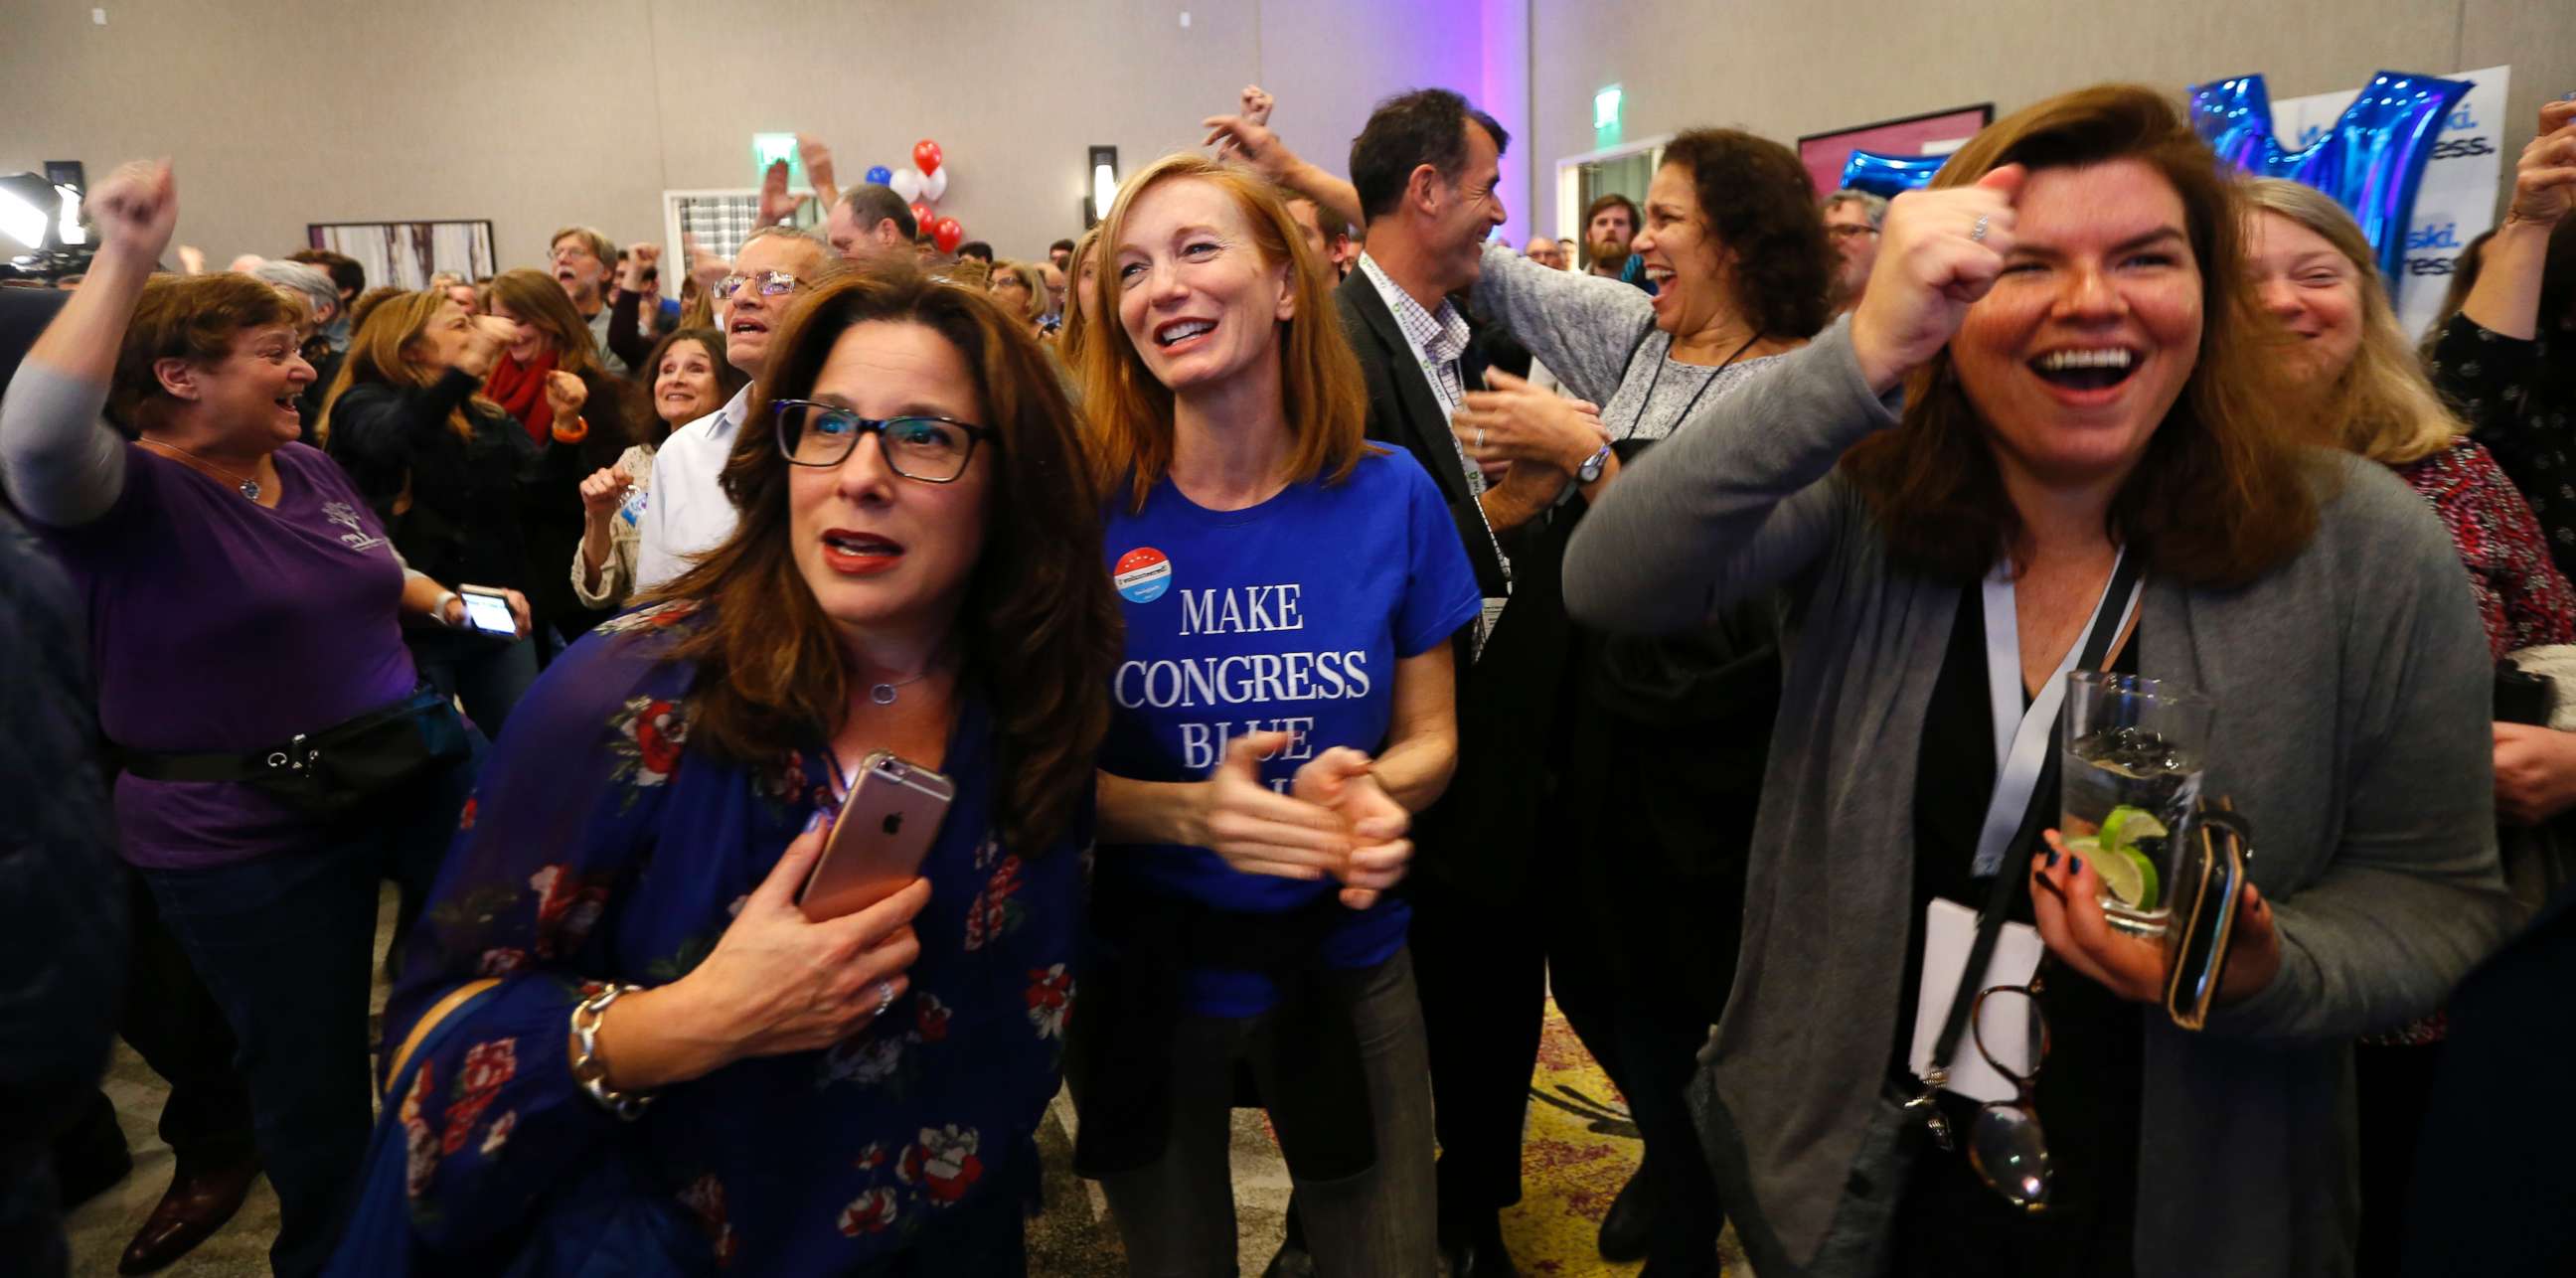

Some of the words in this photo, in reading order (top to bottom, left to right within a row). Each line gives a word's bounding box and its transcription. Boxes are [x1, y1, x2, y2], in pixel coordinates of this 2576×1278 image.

[2407, 224, 2460, 249] ski.
[1179, 583, 1304, 635] MAKE
[1114, 650, 1370, 709] CONGRESS
